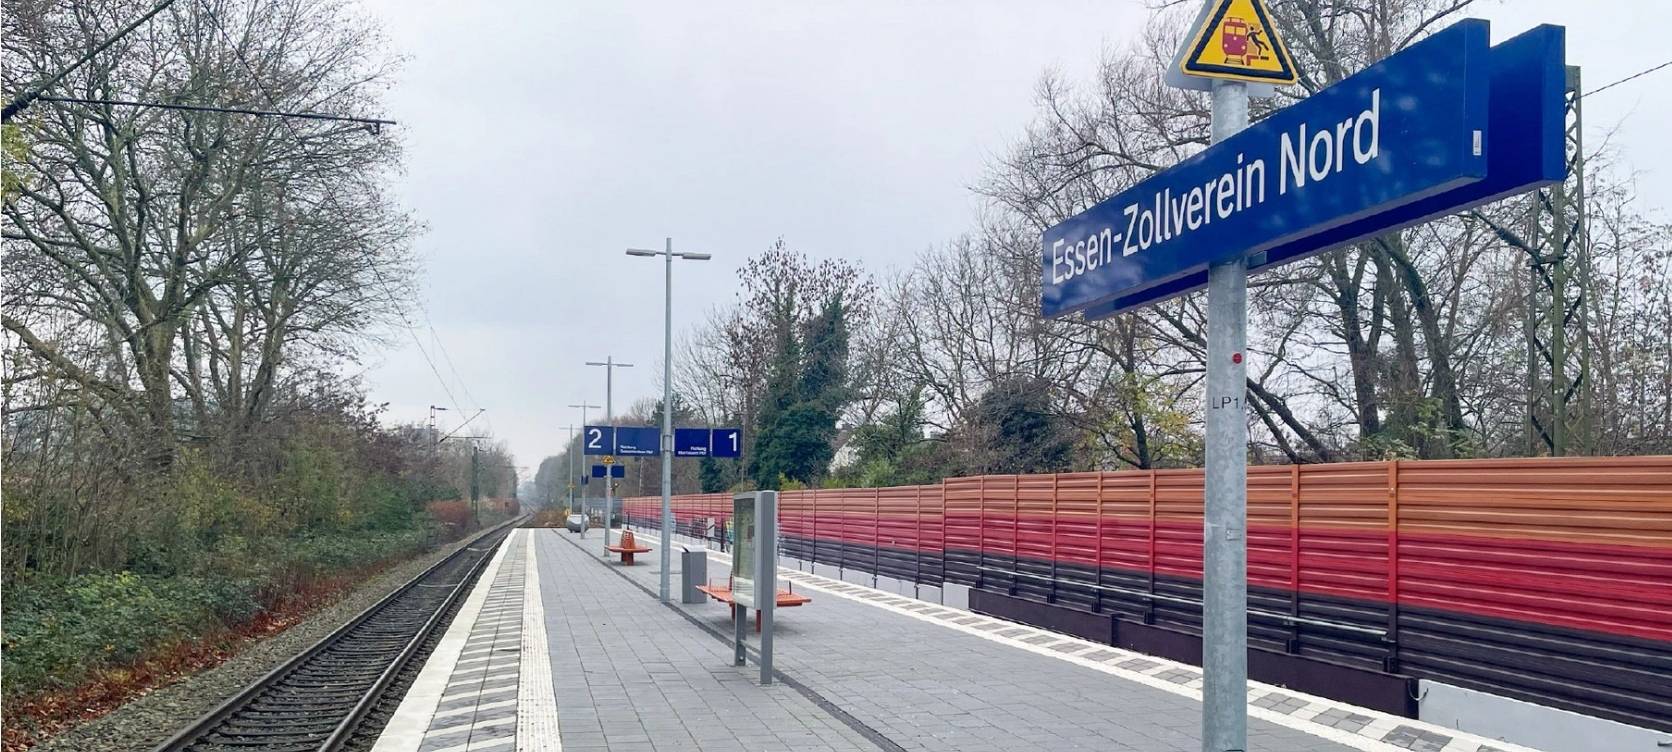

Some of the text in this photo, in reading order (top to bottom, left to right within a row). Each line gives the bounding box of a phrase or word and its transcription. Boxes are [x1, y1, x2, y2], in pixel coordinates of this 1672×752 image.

[1052, 88, 1381, 286] Essen-Zollverein Nord
[588, 428, 602, 449] 2
[728, 432, 737, 452] 1
